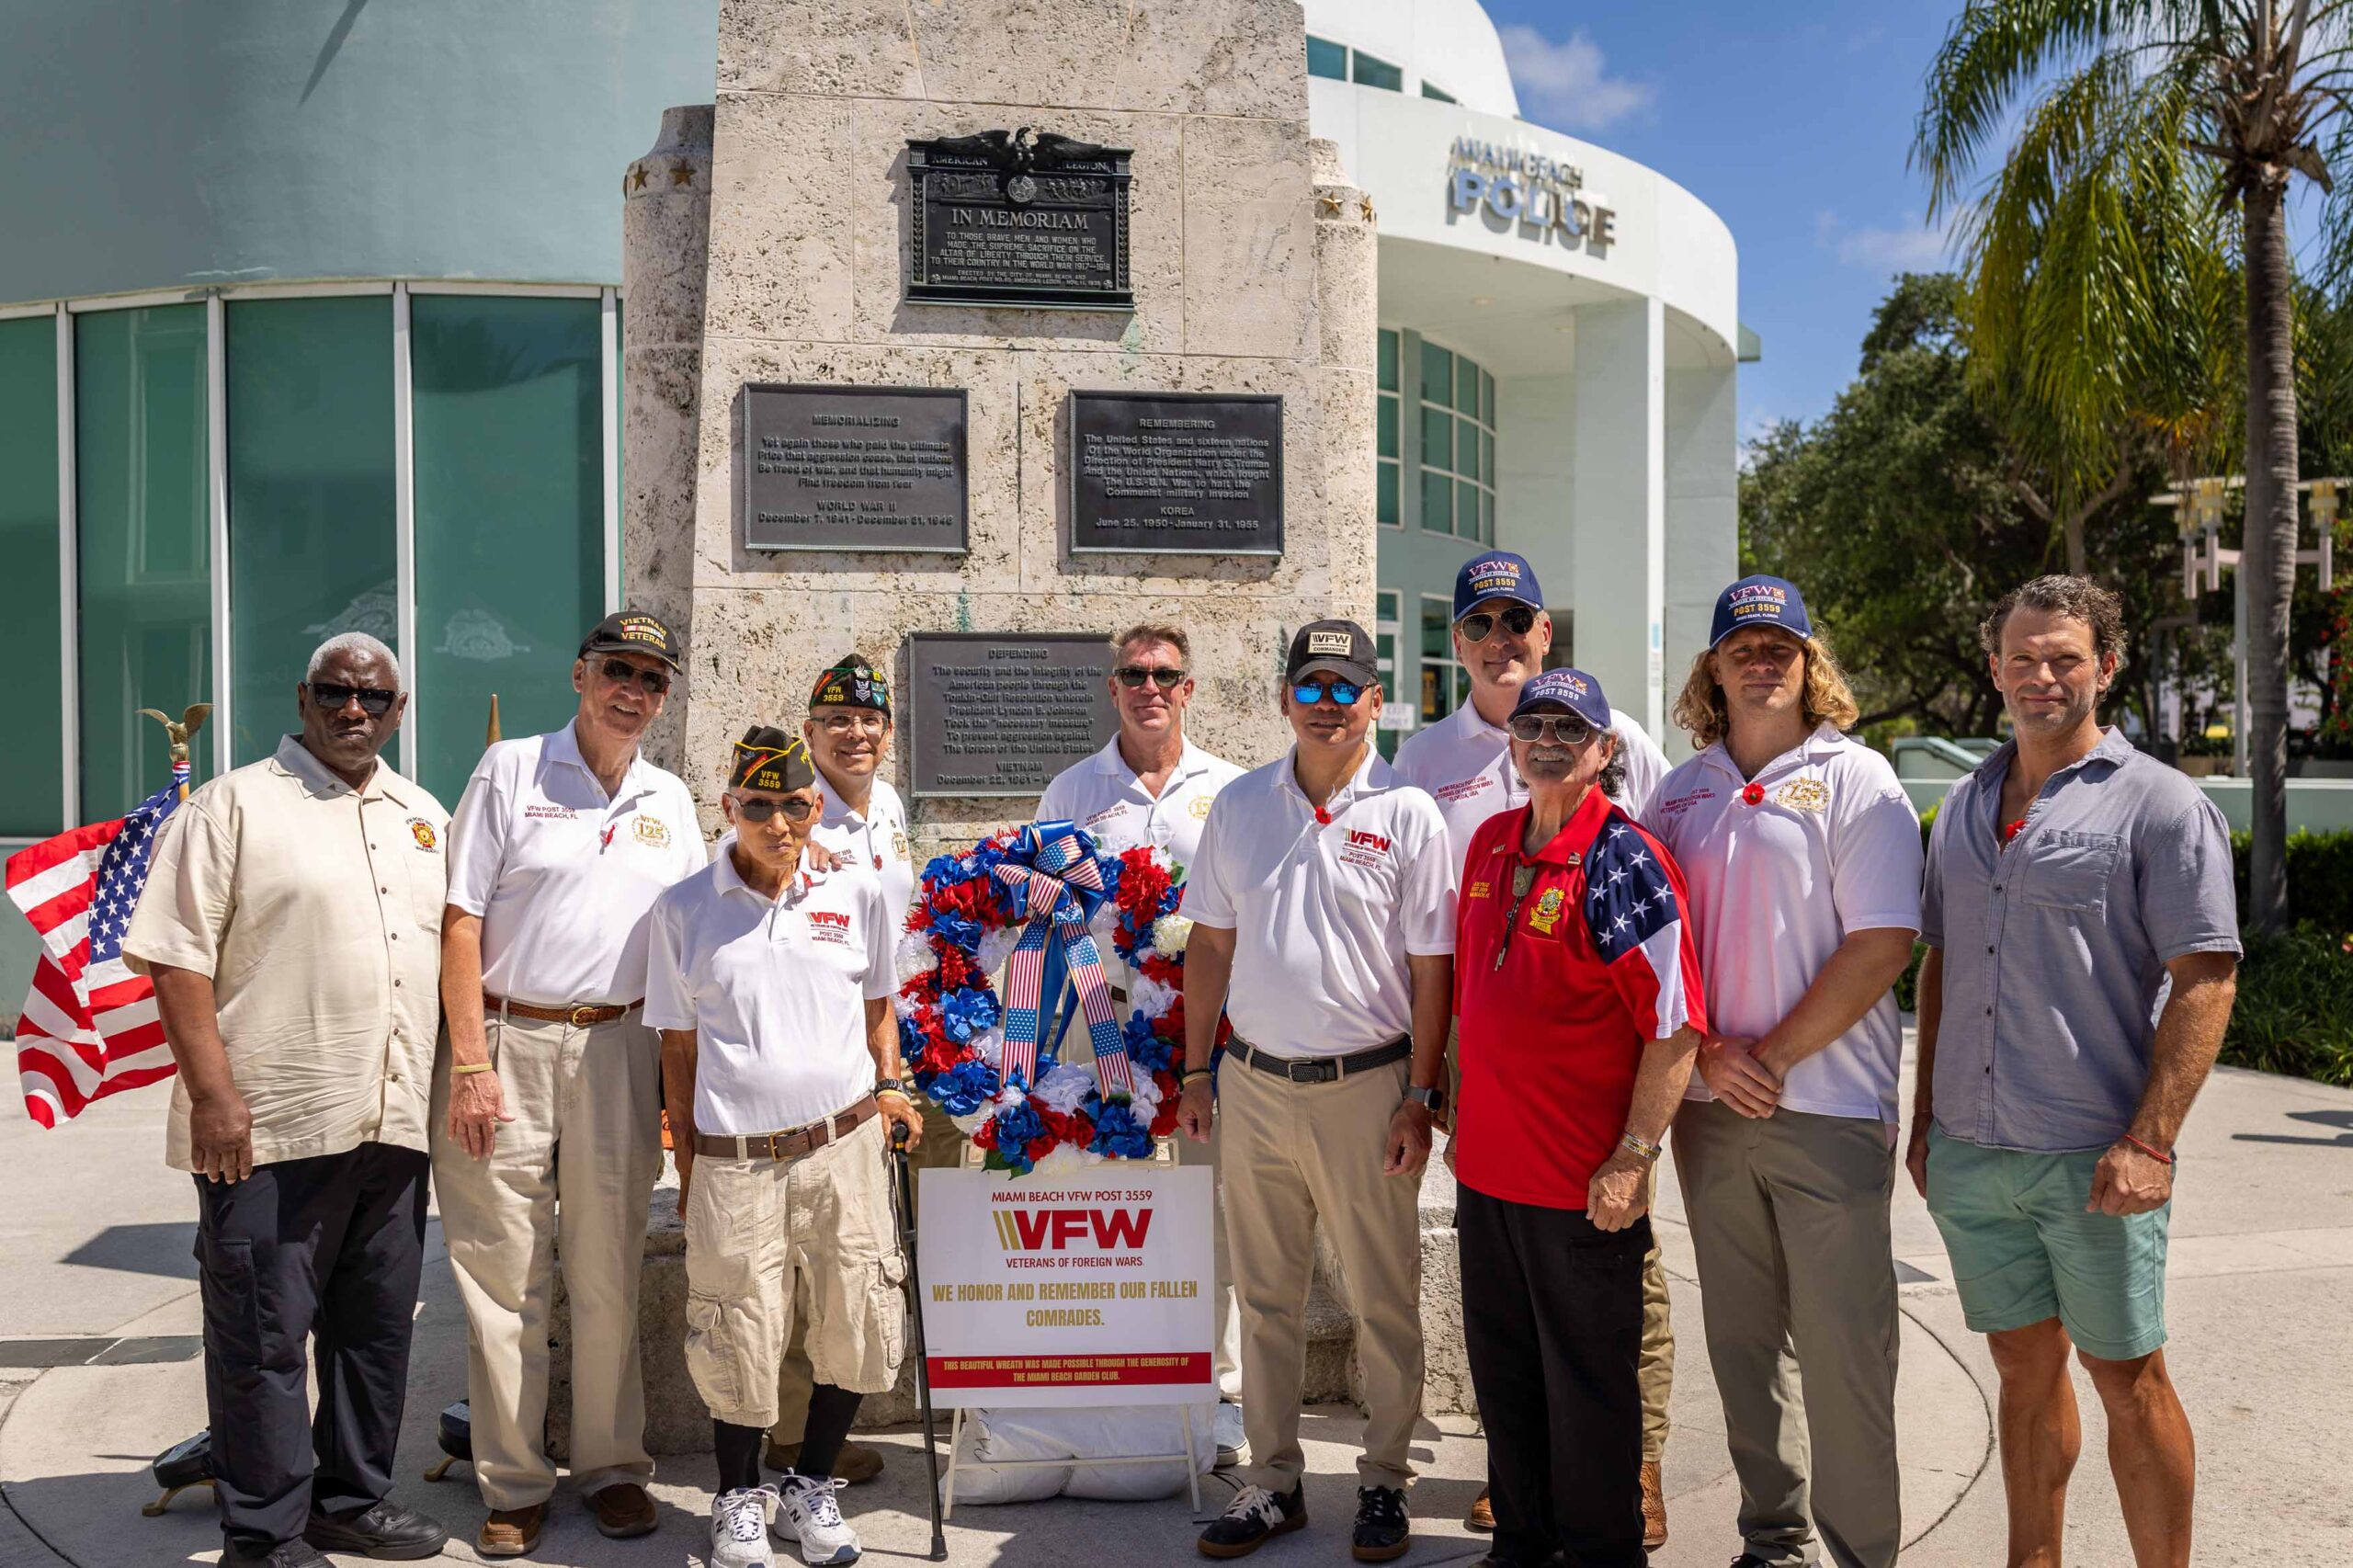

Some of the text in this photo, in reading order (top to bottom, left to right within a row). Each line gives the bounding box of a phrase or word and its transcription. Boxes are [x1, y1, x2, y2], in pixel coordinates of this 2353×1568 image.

[931, 154, 1108, 172] AMERICAN LEGION
[1453, 168, 1616, 245] POLICE
[952, 209, 1089, 230] IN MEMORIAM
[988, 243, 1026, 251] SUPREME
[1026, 244, 1067, 253] SACRIFICE
[981, 251, 1014, 259] LIBERTY
[1014, 252, 1048, 260] THROUGH
[1074, 255, 1105, 263] SERVICE
[812, 415, 900, 428] MEMORIALIZING
[1139, 418, 1215, 429] REMEMBERING
[1085, 435, 1269, 447] The United States and sixteen nations
[1088, 446, 1265, 460] Of the World Organization under the
[1084, 457, 1270, 470] Direction of President Harry S. Truman
[1084, 467, 1270, 481] And the United Nations, which fought
[1103, 478, 1123, 487] The
[1171, 479, 1191, 488] War
[1195, 479, 1207, 488] to
[1209, 480, 1231, 489] halt
[1233, 480, 1251, 489] the
[1106, 488, 1249, 500] Communist military invasion
[817, 500, 897, 513] WORLD WAR II
[1160, 506, 1195, 517] KOREA
[1096, 518, 1120, 528] June
[1234, 520, 1259, 529] 1955
[1469, 561, 1508, 576] VFW
[1473, 579, 1494, 591] POST
[1495, 577, 1516, 587] 3559
[1729, 585, 1773, 601] VFW
[1733, 604, 1756, 617] POST
[1757, 603, 1780, 613] 3559
[619, 617, 667, 637] VIETNAM
[620, 631, 666, 650] VETERAN
[1317, 634, 1349, 644] VFW
[988, 649, 1049, 659] DEFENDING
[1536, 673, 1578, 687] VFW
[827, 686, 842, 694] VFW
[1535, 688, 1556, 699] POST
[1557, 689, 1579, 700] 3559
[823, 694, 845, 702] 3559
[995, 762, 1043, 773] VIETNAM
[761, 770, 779, 780] VFW
[758, 778, 781, 789] 3559
[1351, 829, 1392, 852] VFW
[810, 912, 850, 927] VFW
[992, 1190, 1153, 1202] MIAMI BEACH VFW POST 3559
[1014, 1209, 1154, 1250] VFW
[1006, 1257, 1056, 1268] VETERANS
[1058, 1257, 1070, 1268] OF
[1073, 1256, 1112, 1267] FOREIGN
[932, 1281, 1198, 1302] WE HONOR AND REMEMBER OUR FALLEN
[1026, 1309, 1106, 1326] COMRADES.
[943, 1357, 1189, 1370] THIS BEAUTIFUL WREATH WAS MADE POSSIBLE THROUGH THE GENEROSITY OF
[1013, 1371, 1120, 1382] THE MIAMI BEACH GARDEN CLUB.
